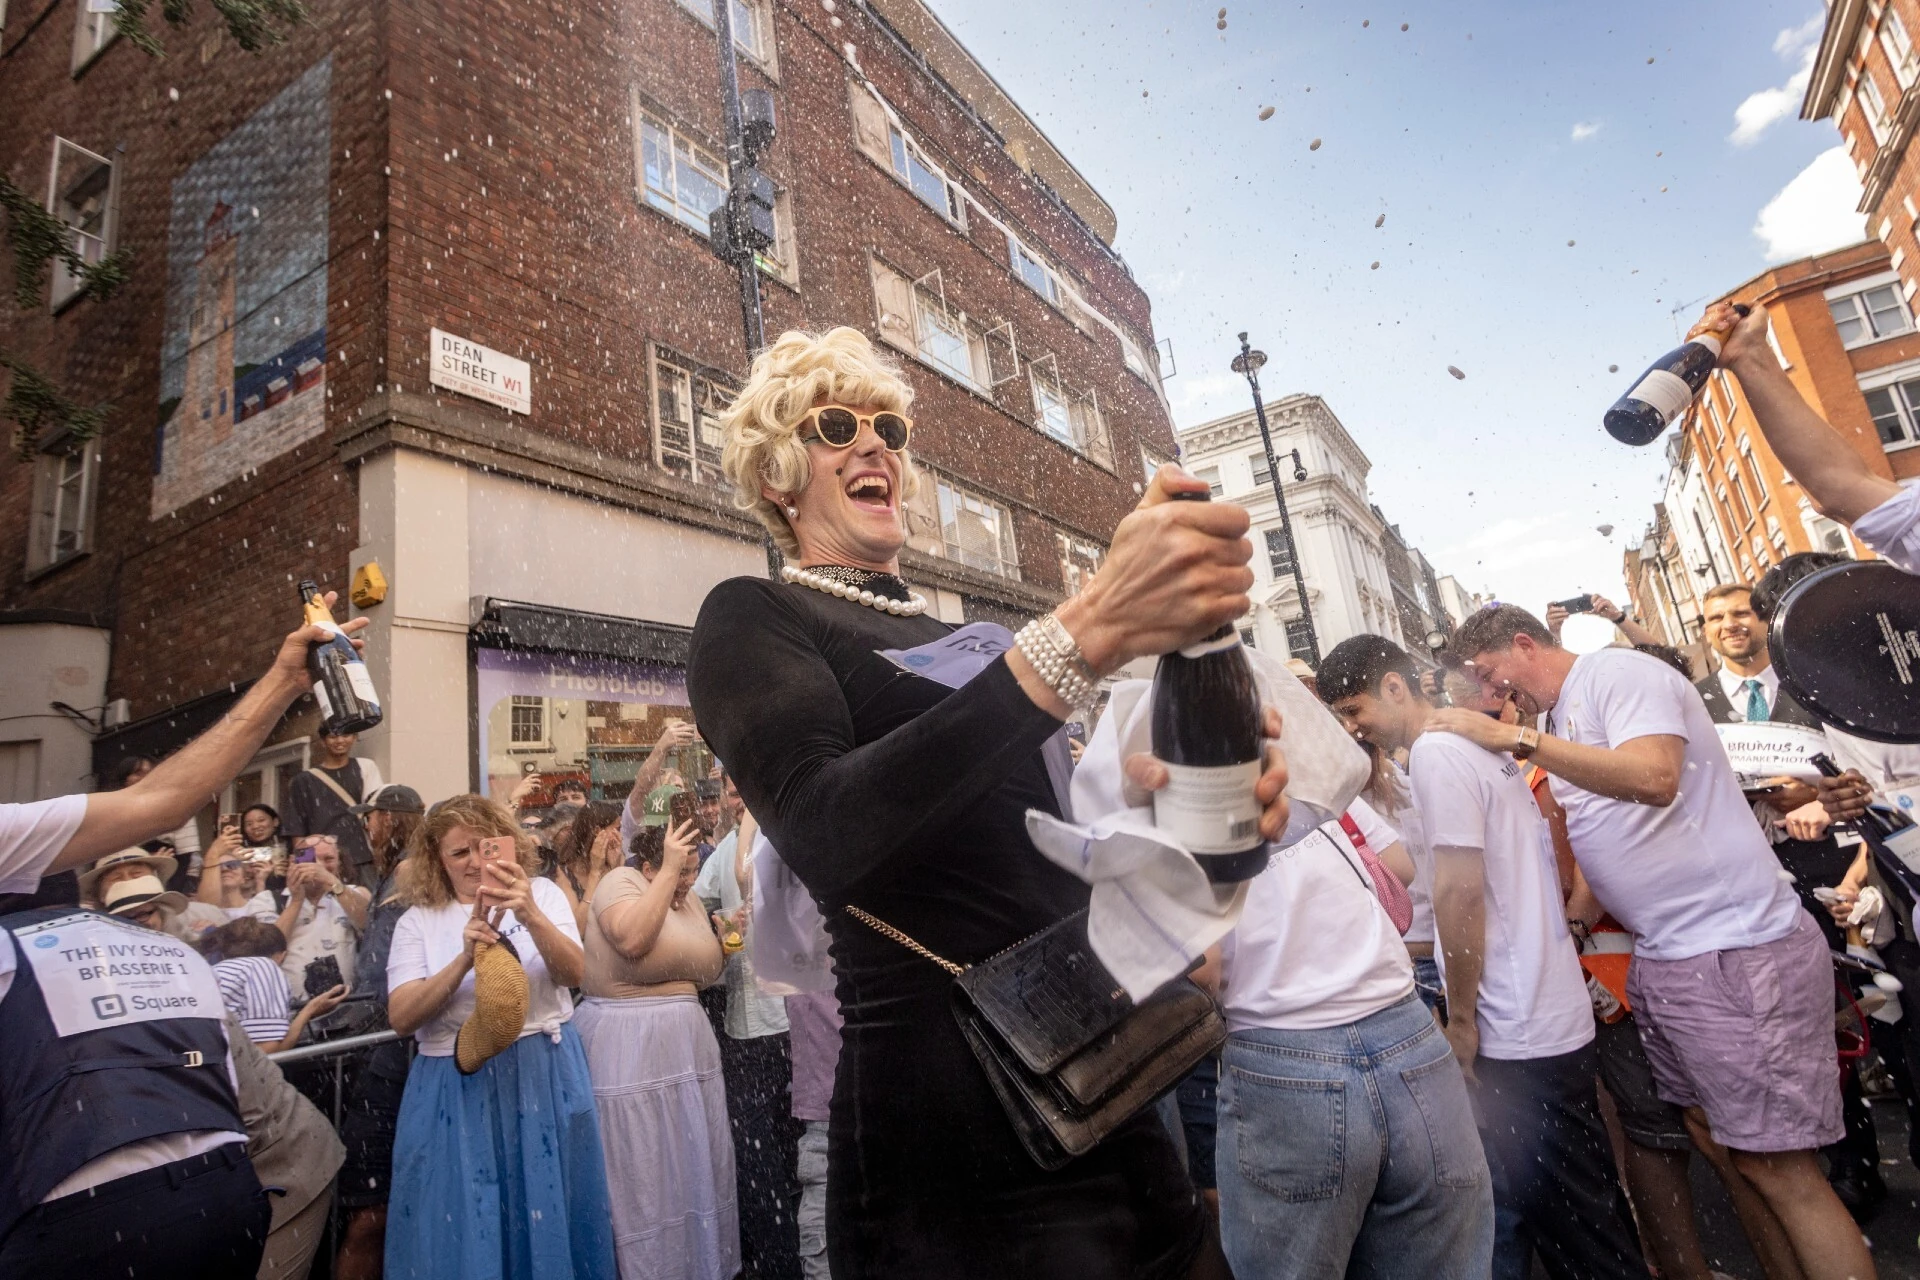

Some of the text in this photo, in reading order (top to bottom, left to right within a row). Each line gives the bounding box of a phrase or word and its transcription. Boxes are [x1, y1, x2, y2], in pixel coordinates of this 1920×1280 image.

[442, 337, 483, 363] DEAN
[442, 355, 523, 395] STREET W1
[441, 377, 518, 407] CITY OF WESTMINSTER
[549, 666, 665, 696] PhotoLab
[1728, 741, 1805, 753] BRUMUS 4
[651, 797, 665, 813] NY
[1285, 846, 1301, 858] OF
[60, 943, 186, 962] THE IVY SOHO
[78, 963, 189, 981] BRASSERIE 1
[131, 995, 198, 1012] Square
